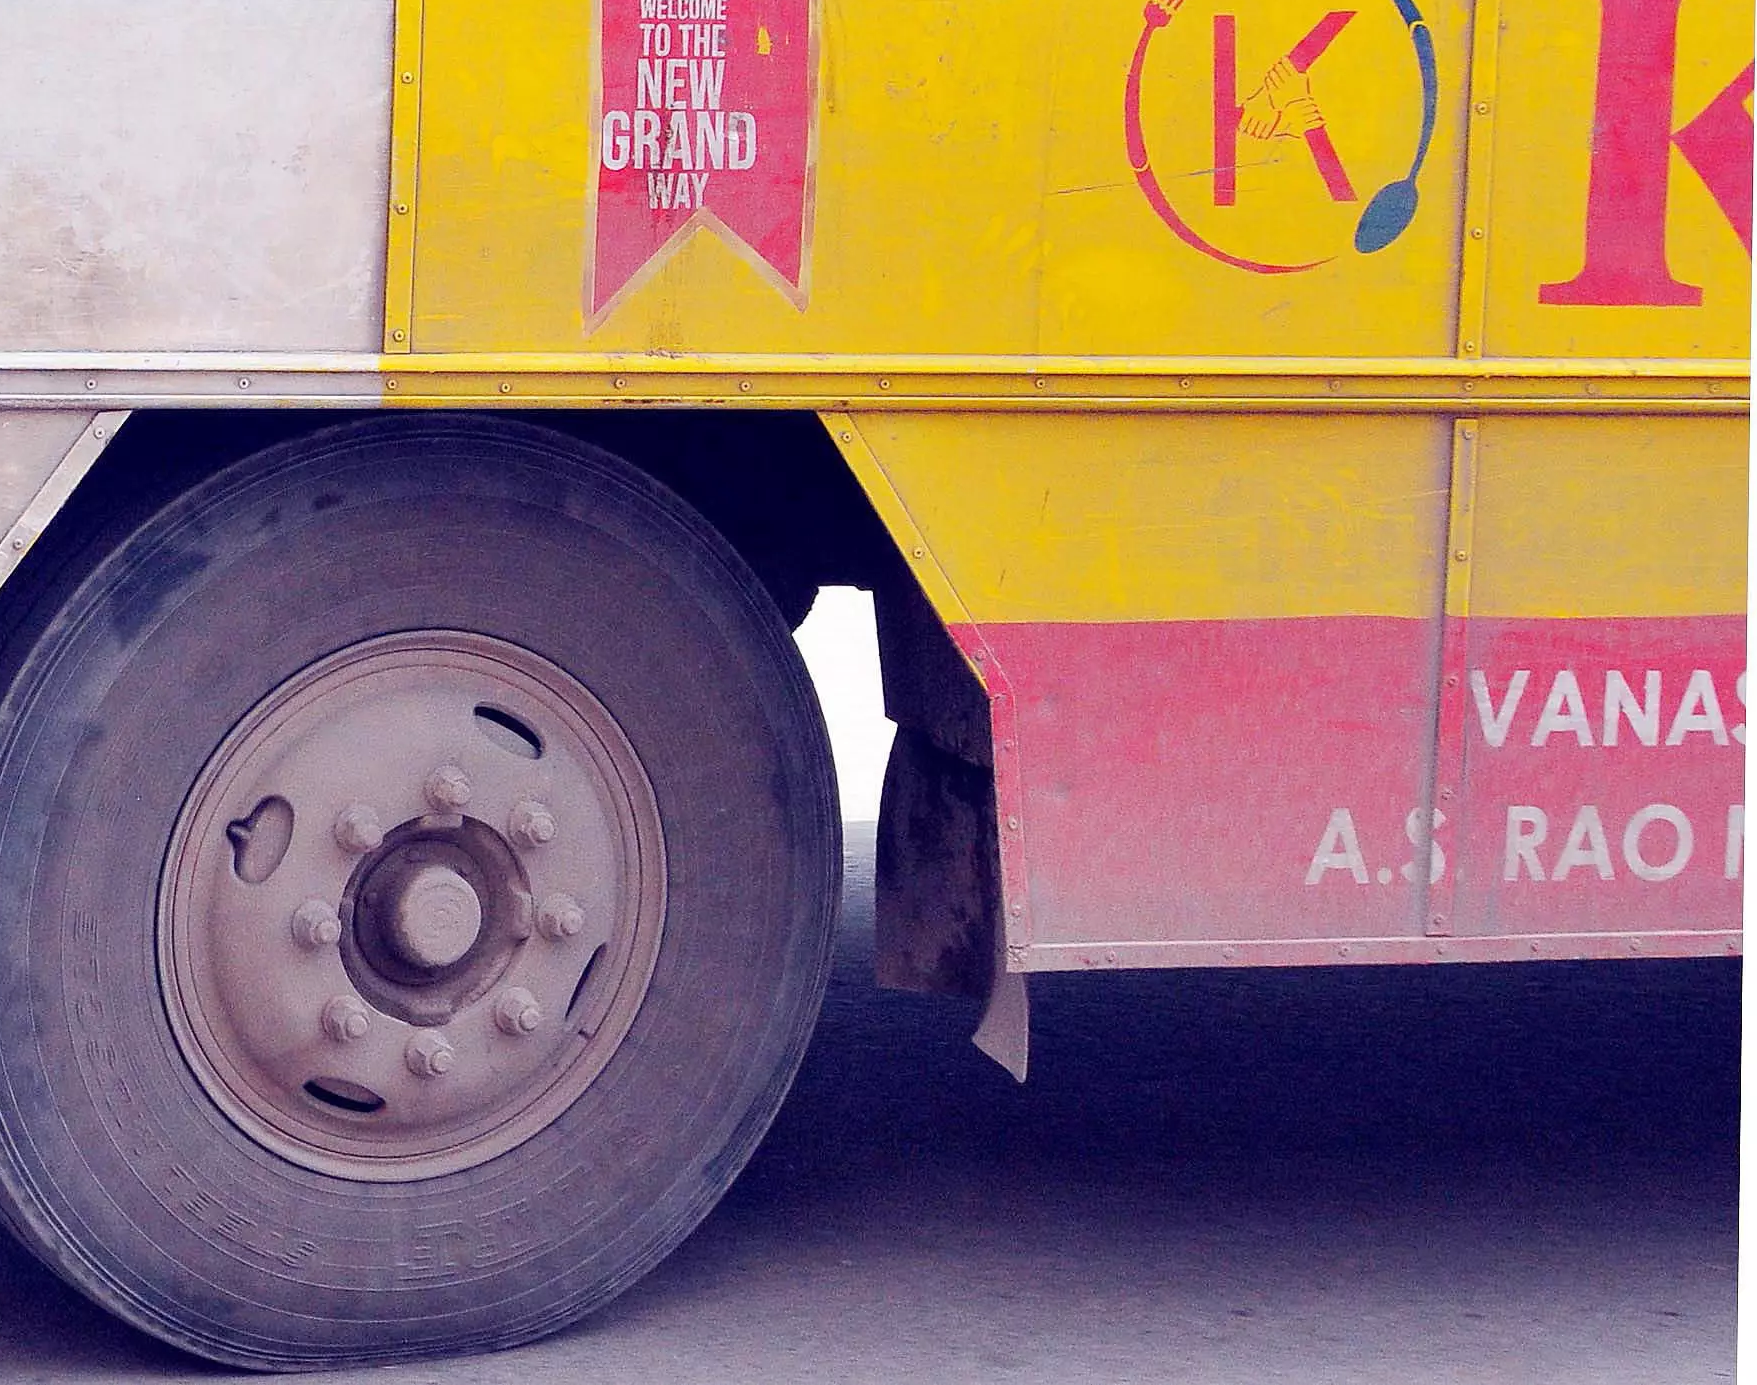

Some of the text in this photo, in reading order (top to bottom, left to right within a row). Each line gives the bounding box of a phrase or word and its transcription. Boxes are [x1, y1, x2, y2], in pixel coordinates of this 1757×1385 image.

[638, 23, 727, 57] TO THE
[637, 57, 725, 111] NEW
[601, 110, 757, 171] GRAND
[647, 171, 710, 211] WAY
[1503, 803, 1694, 883] RAO
